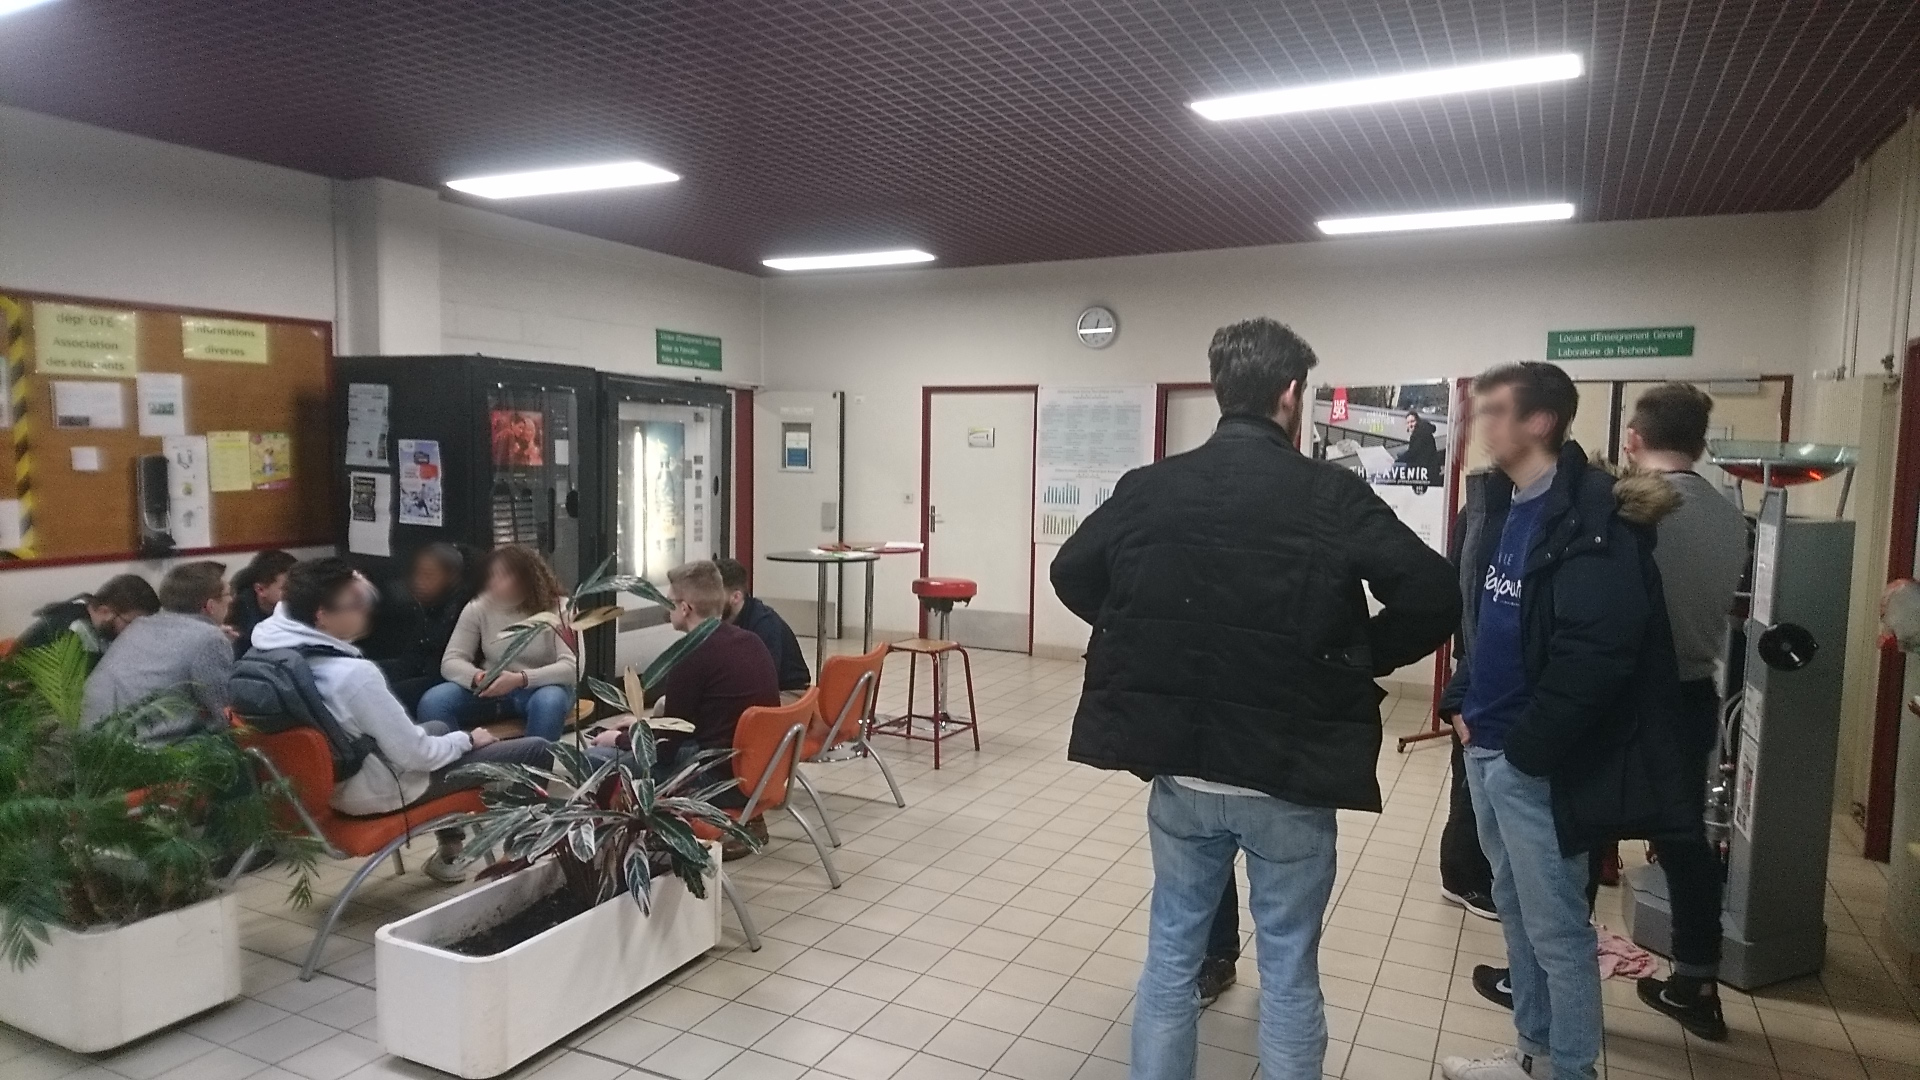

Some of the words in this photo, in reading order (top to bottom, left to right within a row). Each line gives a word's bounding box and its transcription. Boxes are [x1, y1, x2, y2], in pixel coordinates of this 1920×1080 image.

[53, 336, 118, 350] Association
[1559, 333, 1587, 343] Locaux
[204, 344, 245, 356] diverses
[1604, 347, 1614, 356] de
[1617, 345, 1659, 356] Recherche
[46, 356, 67, 368] des
[70, 358, 125, 371] étuants
